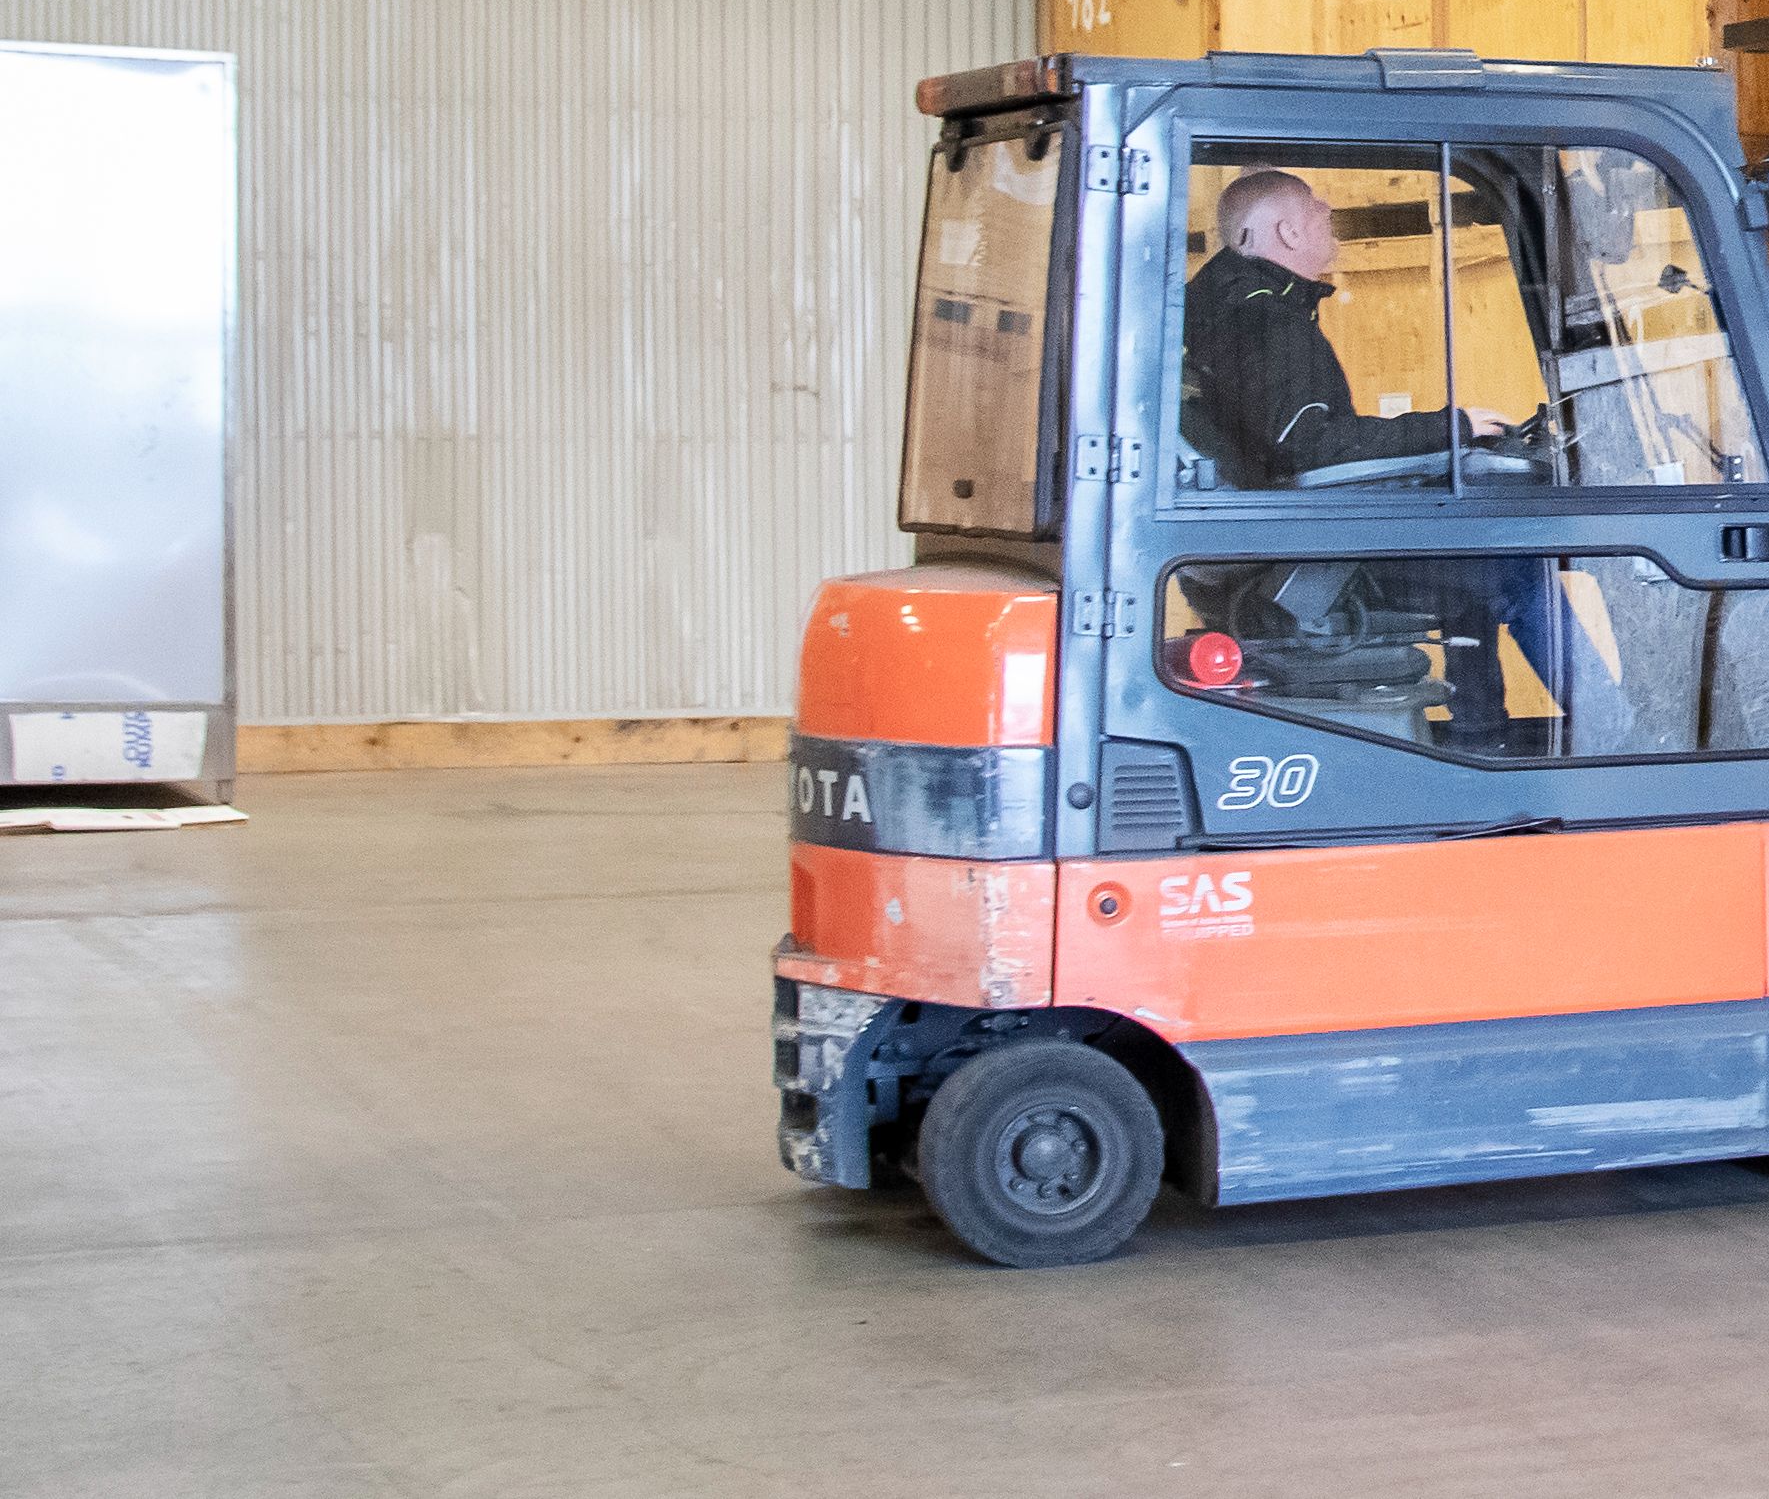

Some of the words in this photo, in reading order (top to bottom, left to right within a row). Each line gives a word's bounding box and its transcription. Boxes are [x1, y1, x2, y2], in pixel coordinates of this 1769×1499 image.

[793, 766, 873, 823] OTA
[1217, 753, 1319, 810] 30
[1159, 871, 1253, 916] SAS
